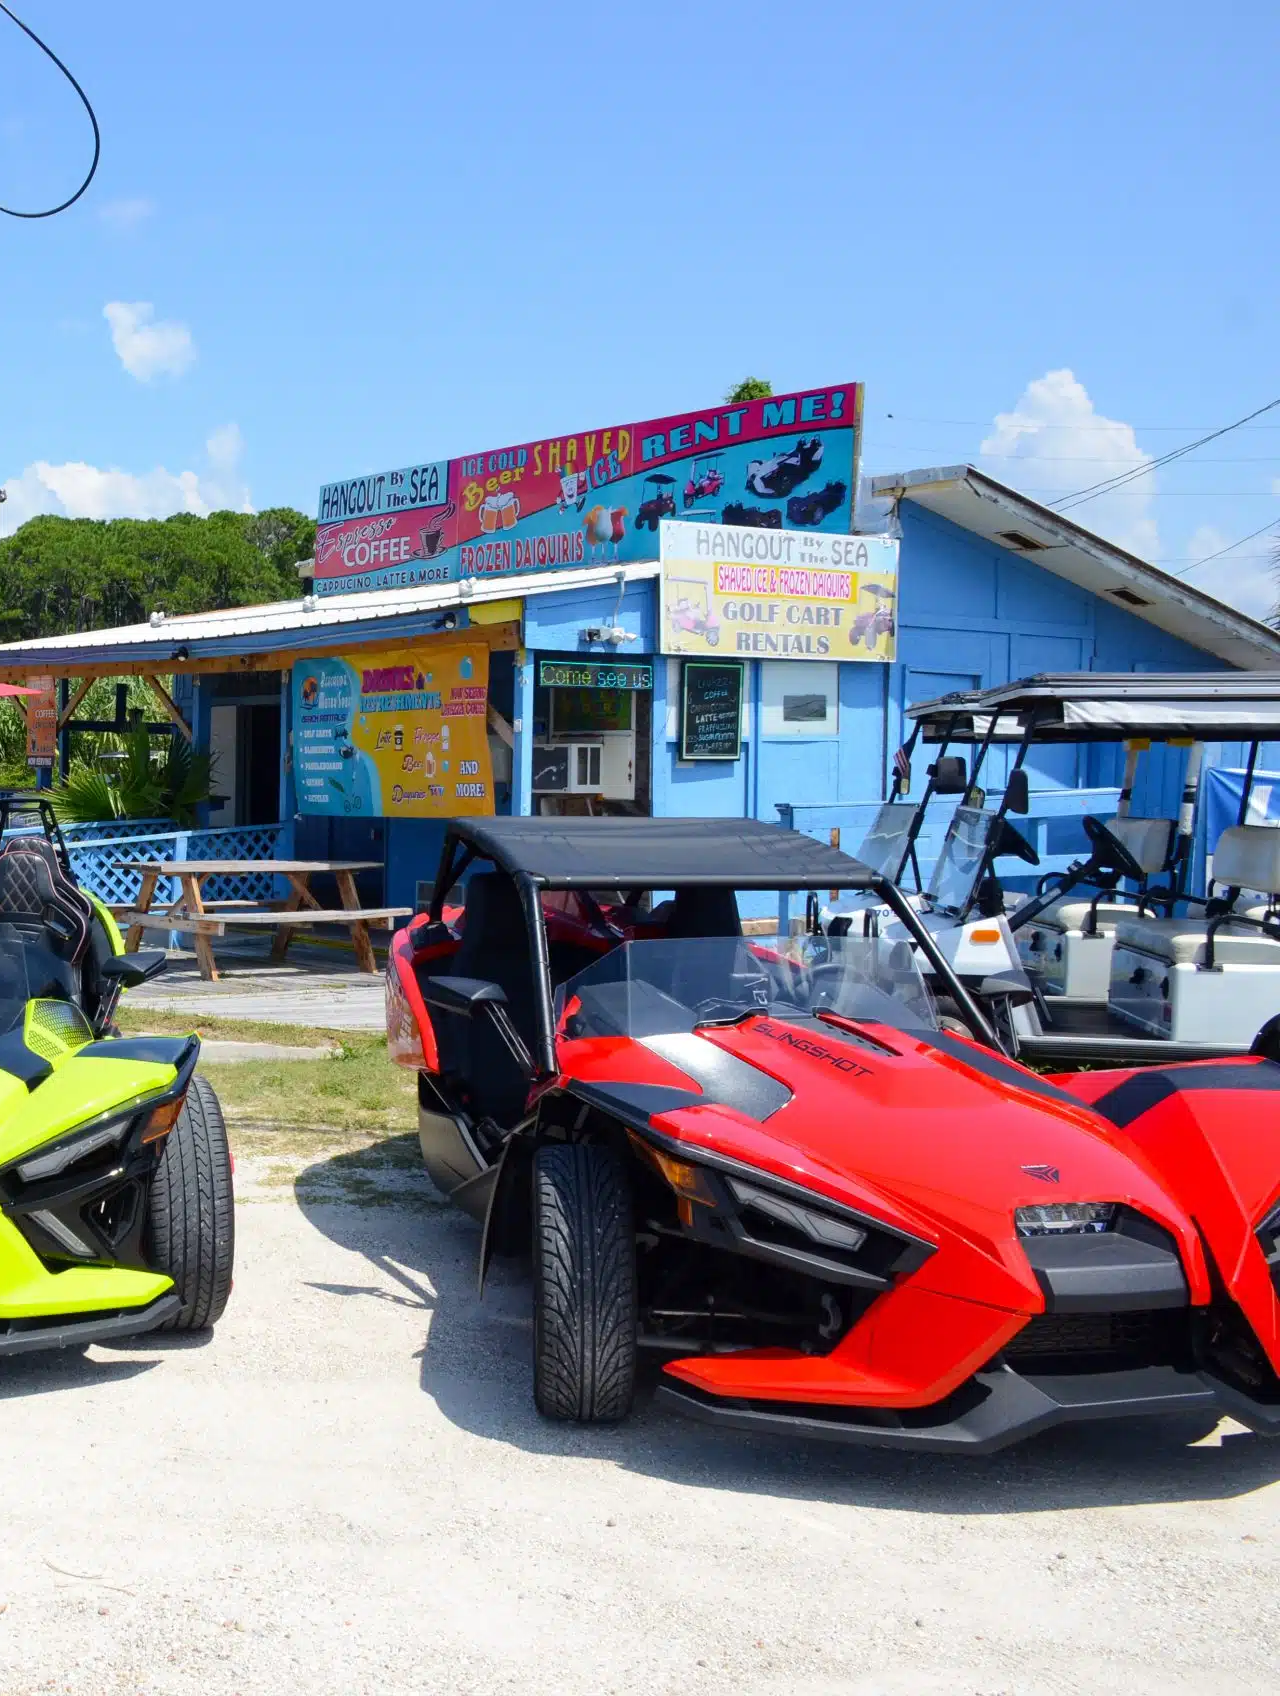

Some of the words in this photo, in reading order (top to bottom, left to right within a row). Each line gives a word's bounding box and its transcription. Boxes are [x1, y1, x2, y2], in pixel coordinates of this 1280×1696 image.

[641, 407, 750, 463] RENT
[762, 390, 847, 429] ME!
[462, 455, 484, 477] ICE
[488, 448, 528, 471] COLD
[533, 429, 630, 476] SHAVED
[386, 493, 408, 508] The
[409, 465, 439, 505] SEA
[584, 449, 622, 492] ICE
[321, 475, 386, 520] HANGOUT
[390, 471, 405, 488] By
[463, 467, 524, 512] Beer
[317, 516, 397, 564] Espresso
[343, 536, 411, 567] COFFEE
[460, 540, 512, 576] FROZEN
[515, 530, 585, 570] DAIQUIRIS
[696, 528, 796, 563] HANGOUT
[802, 537, 824, 550] By
[797, 551, 829, 565] The
[831, 540, 869, 567] SEA
[376, 570, 407, 585] LATTE
[409, 571, 416, 582] &
[418, 567, 450, 582] MORE
[718, 565, 752, 592] SHAVED
[754, 567, 768, 593] ICE
[769, 569, 777, 593] &
[779, 569, 811, 595] FROZEN
[722, 601, 781, 623] GOLF
[786, 606, 845, 626] CART
[736, 631, 830, 655] RENTALS
[543, 665, 592, 684] Come
[597, 671, 627, 687] see
[632, 673, 651, 688] us
[460, 760, 479, 775] AND
[456, 782, 485, 798] MORE!
[752, 1023, 875, 1077] SLINGSHOT
